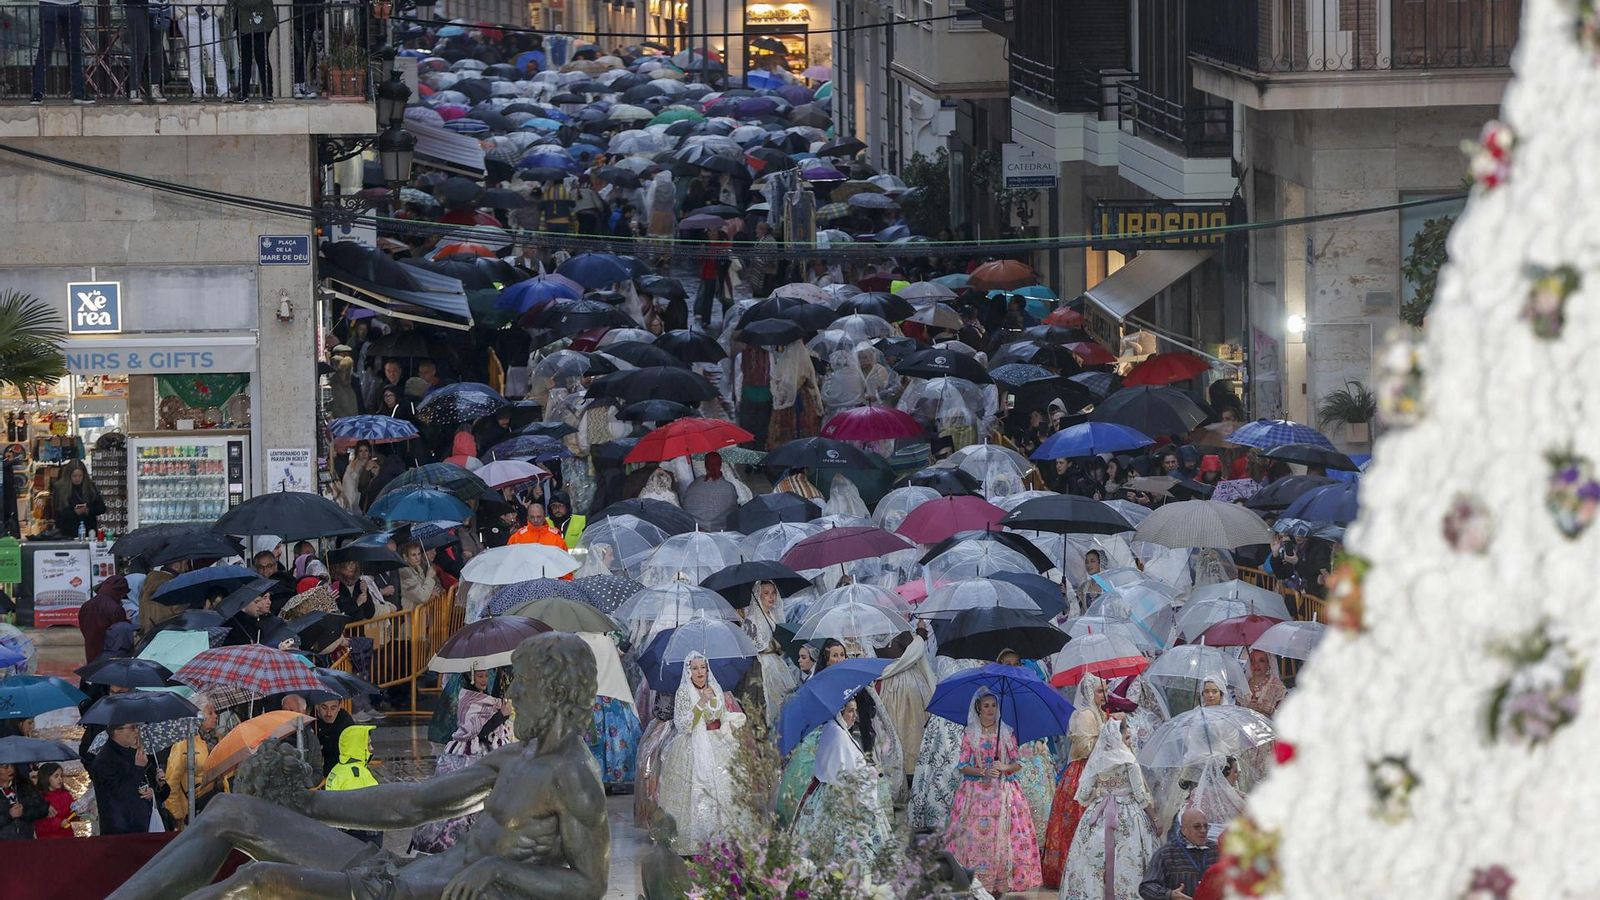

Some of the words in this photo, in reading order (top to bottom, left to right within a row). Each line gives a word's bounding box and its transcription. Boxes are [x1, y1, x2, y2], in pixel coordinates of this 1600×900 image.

[1007, 162, 1052, 171] CATEDRAL
[77, 311, 112, 326] rea
[66, 353, 120, 370] NIRS
[127, 352, 142, 369] &
[149, 351, 214, 368] GIFTS
